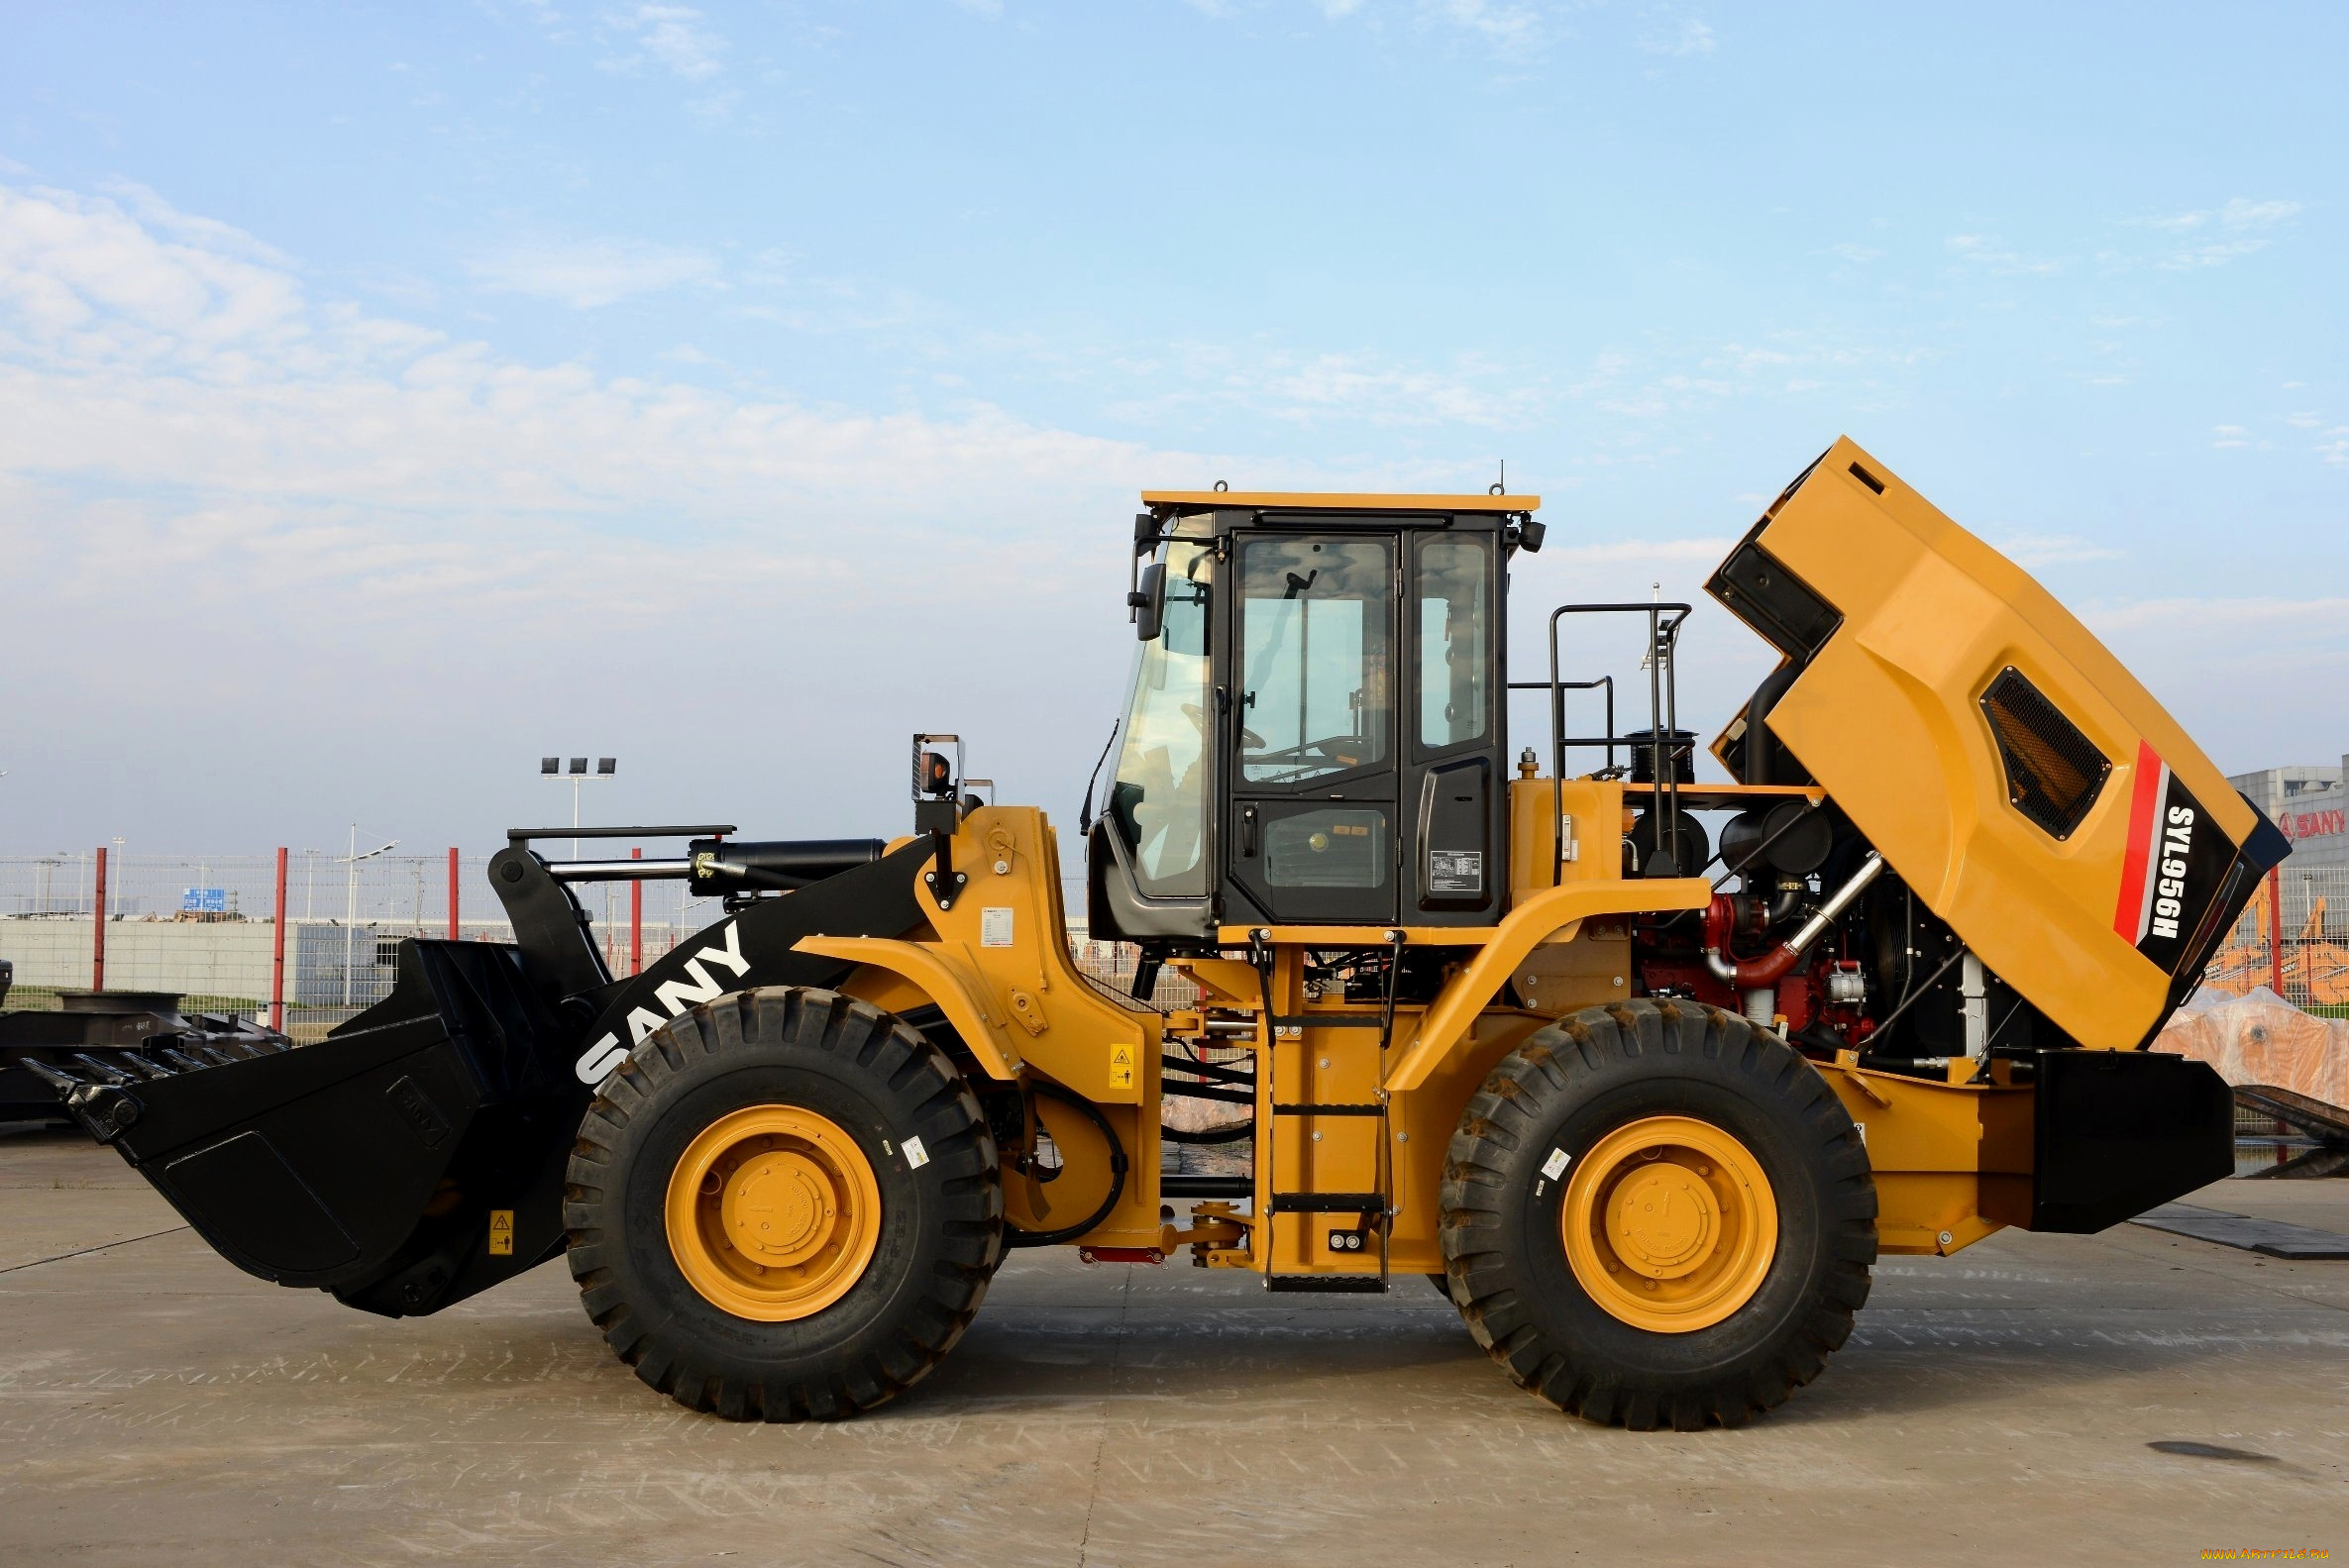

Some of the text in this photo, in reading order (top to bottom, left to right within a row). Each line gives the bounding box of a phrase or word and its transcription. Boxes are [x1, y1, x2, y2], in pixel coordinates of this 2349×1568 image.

[2152, 805, 2194, 939] SYL956H
[2296, 808, 2346, 839] SANY
[575, 919, 751, 1097] SANY
